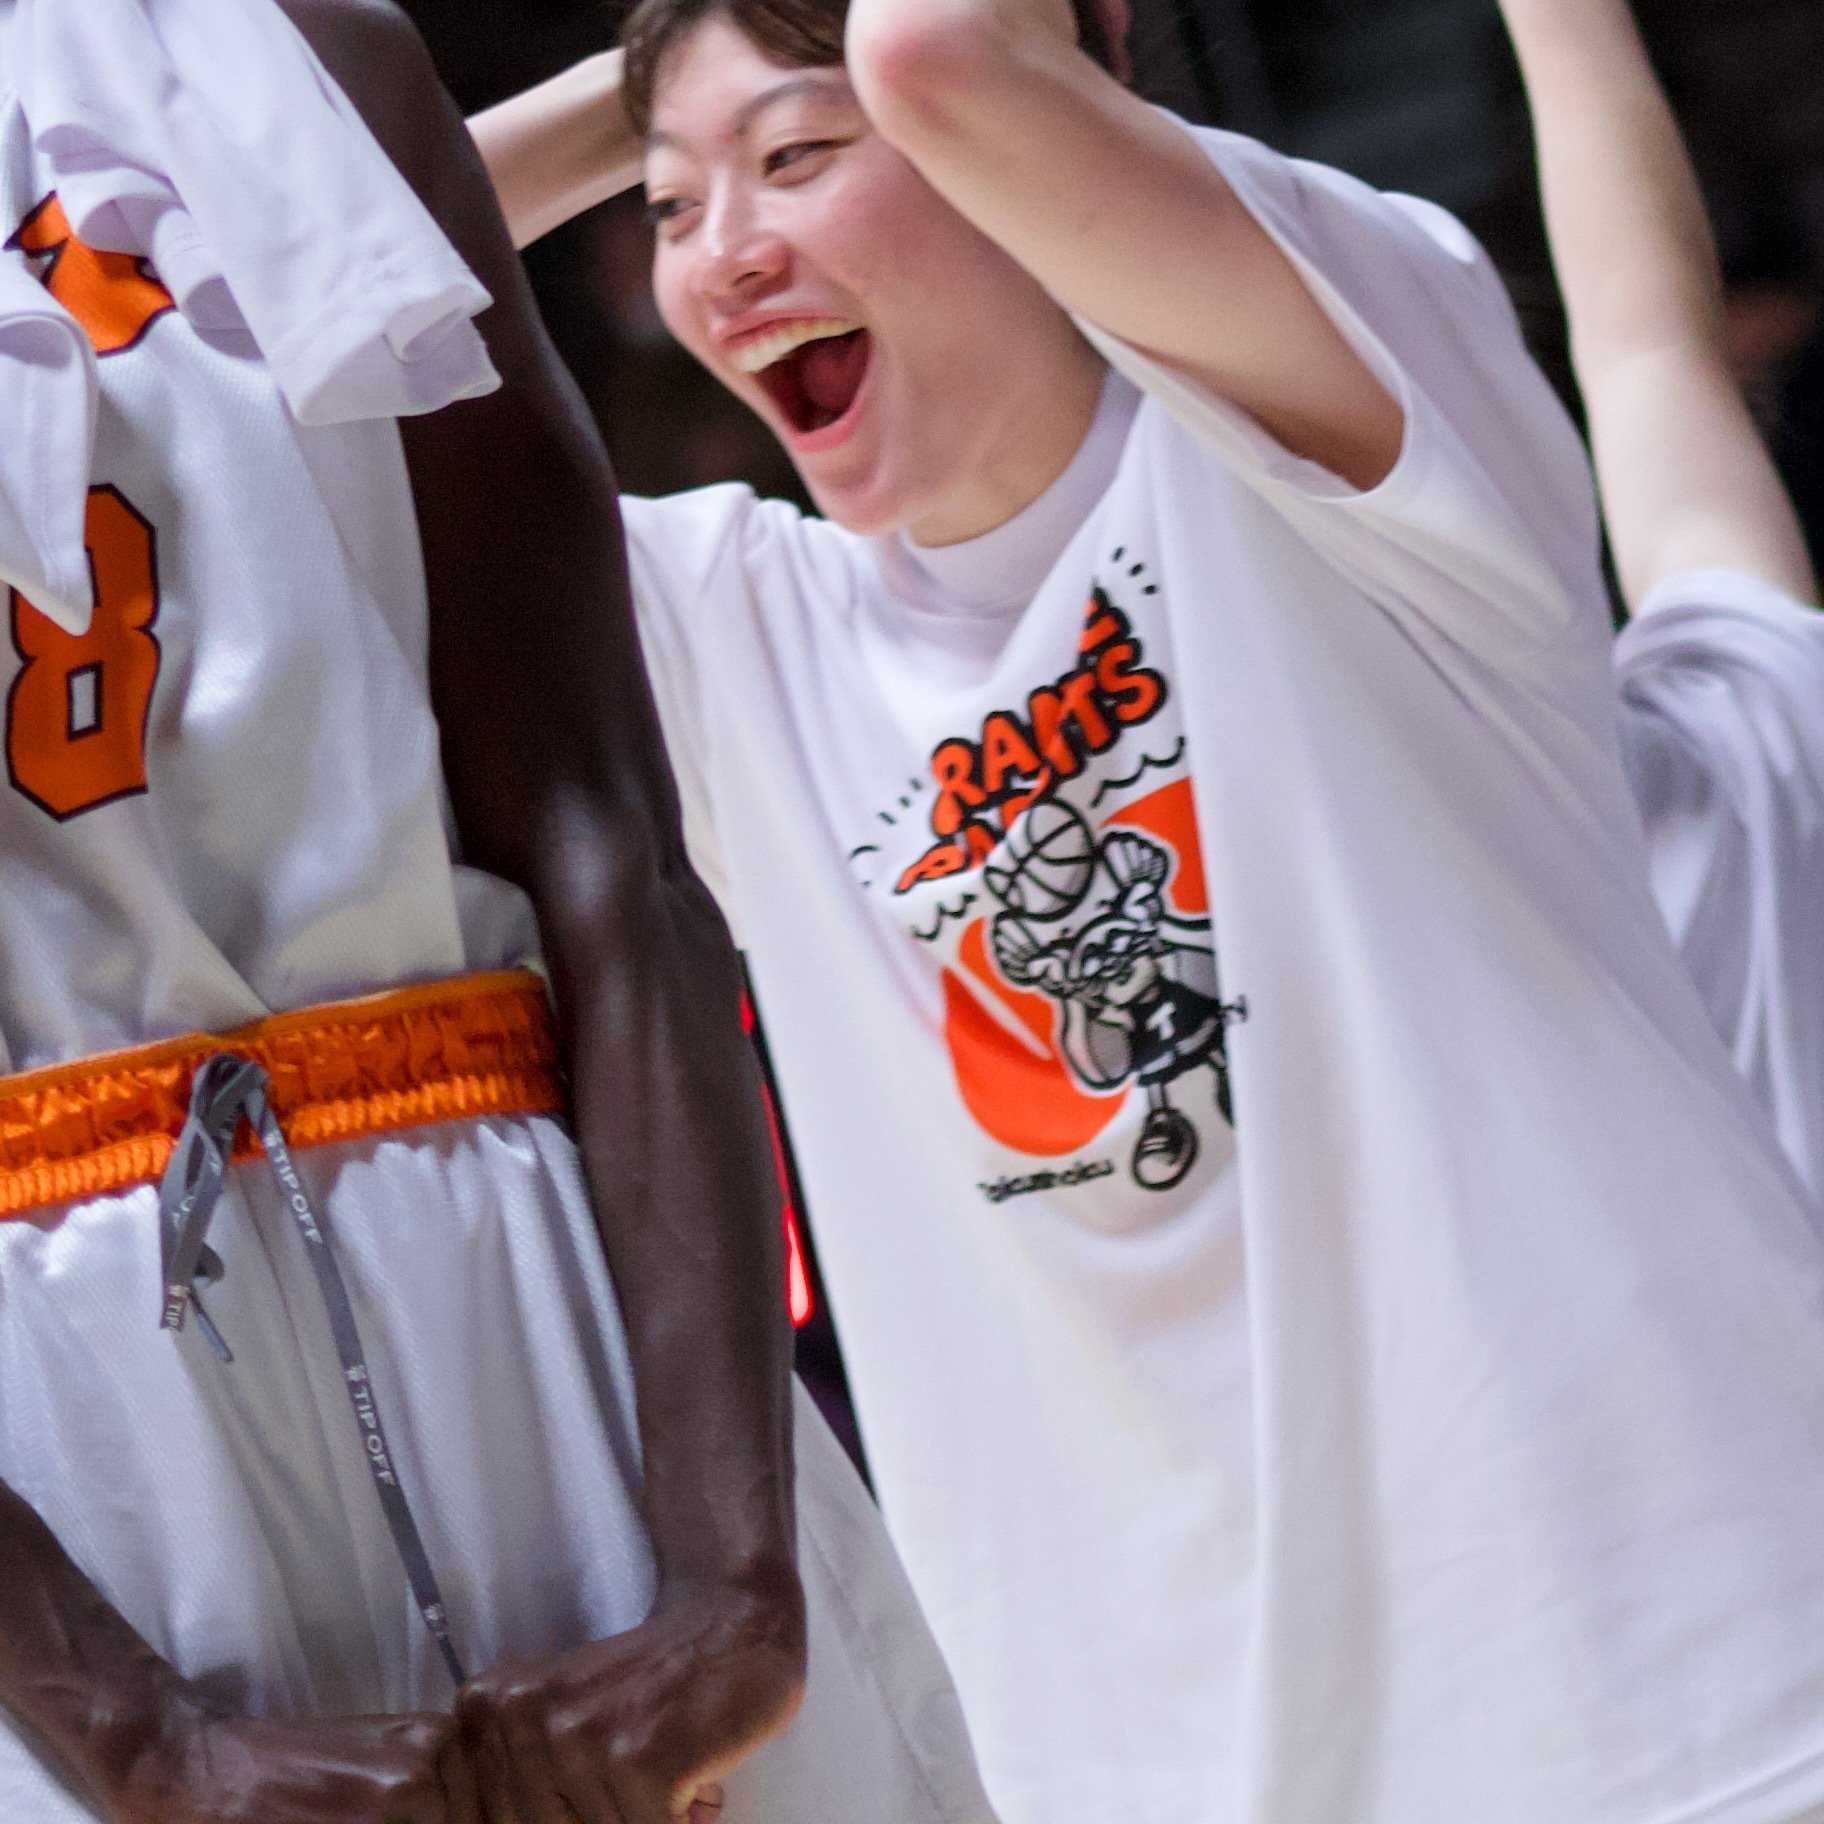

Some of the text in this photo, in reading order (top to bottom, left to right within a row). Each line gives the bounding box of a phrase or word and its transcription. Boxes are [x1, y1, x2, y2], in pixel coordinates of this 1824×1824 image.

[5, 482, 162, 823] 8
[273, 1148, 323, 1244] TIP OFF
[354, 1385, 397, 1487] TIP OFF
